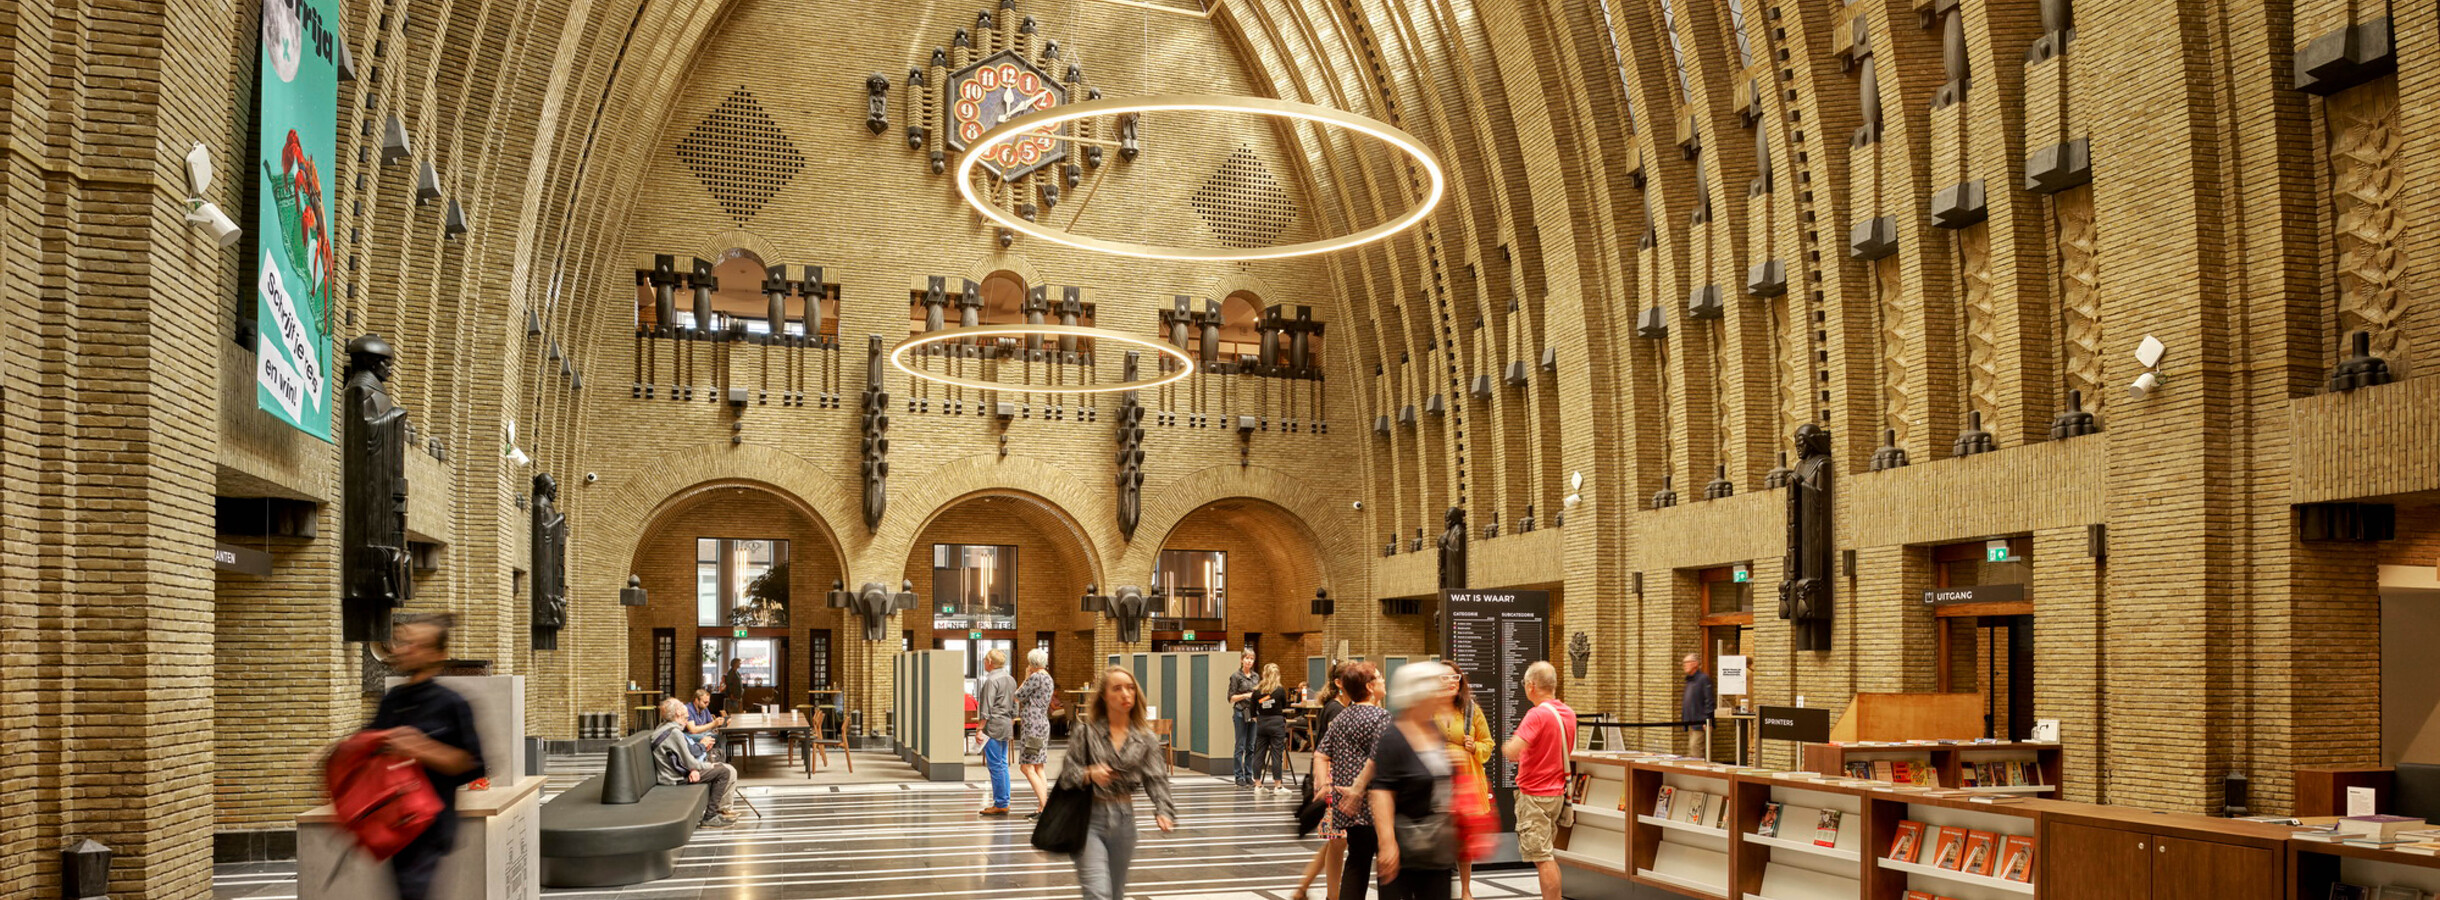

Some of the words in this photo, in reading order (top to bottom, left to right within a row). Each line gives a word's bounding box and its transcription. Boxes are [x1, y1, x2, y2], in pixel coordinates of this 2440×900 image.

[981, 70, 994, 87] 11
[1001, 67, 1016, 84] 12
[964, 84, 982, 99] 10
[1025, 76, 1032, 92] 1
[1039, 92, 1048, 107] 2
[960, 105, 974, 119] 9
[966, 124, 978, 139] 8
[1024, 145, 1035, 160] 5
[265, 358, 278, 380] en
[215, 550, 236, 564] ANTEN
[1450, 594, 1471, 602] WAT
[1473, 594, 1482, 602] IS
[1483, 594, 1515, 603] WAAR?
[1936, 591, 1973, 601] UITGANG
[1764, 718, 1794, 726] SPRINTERS
